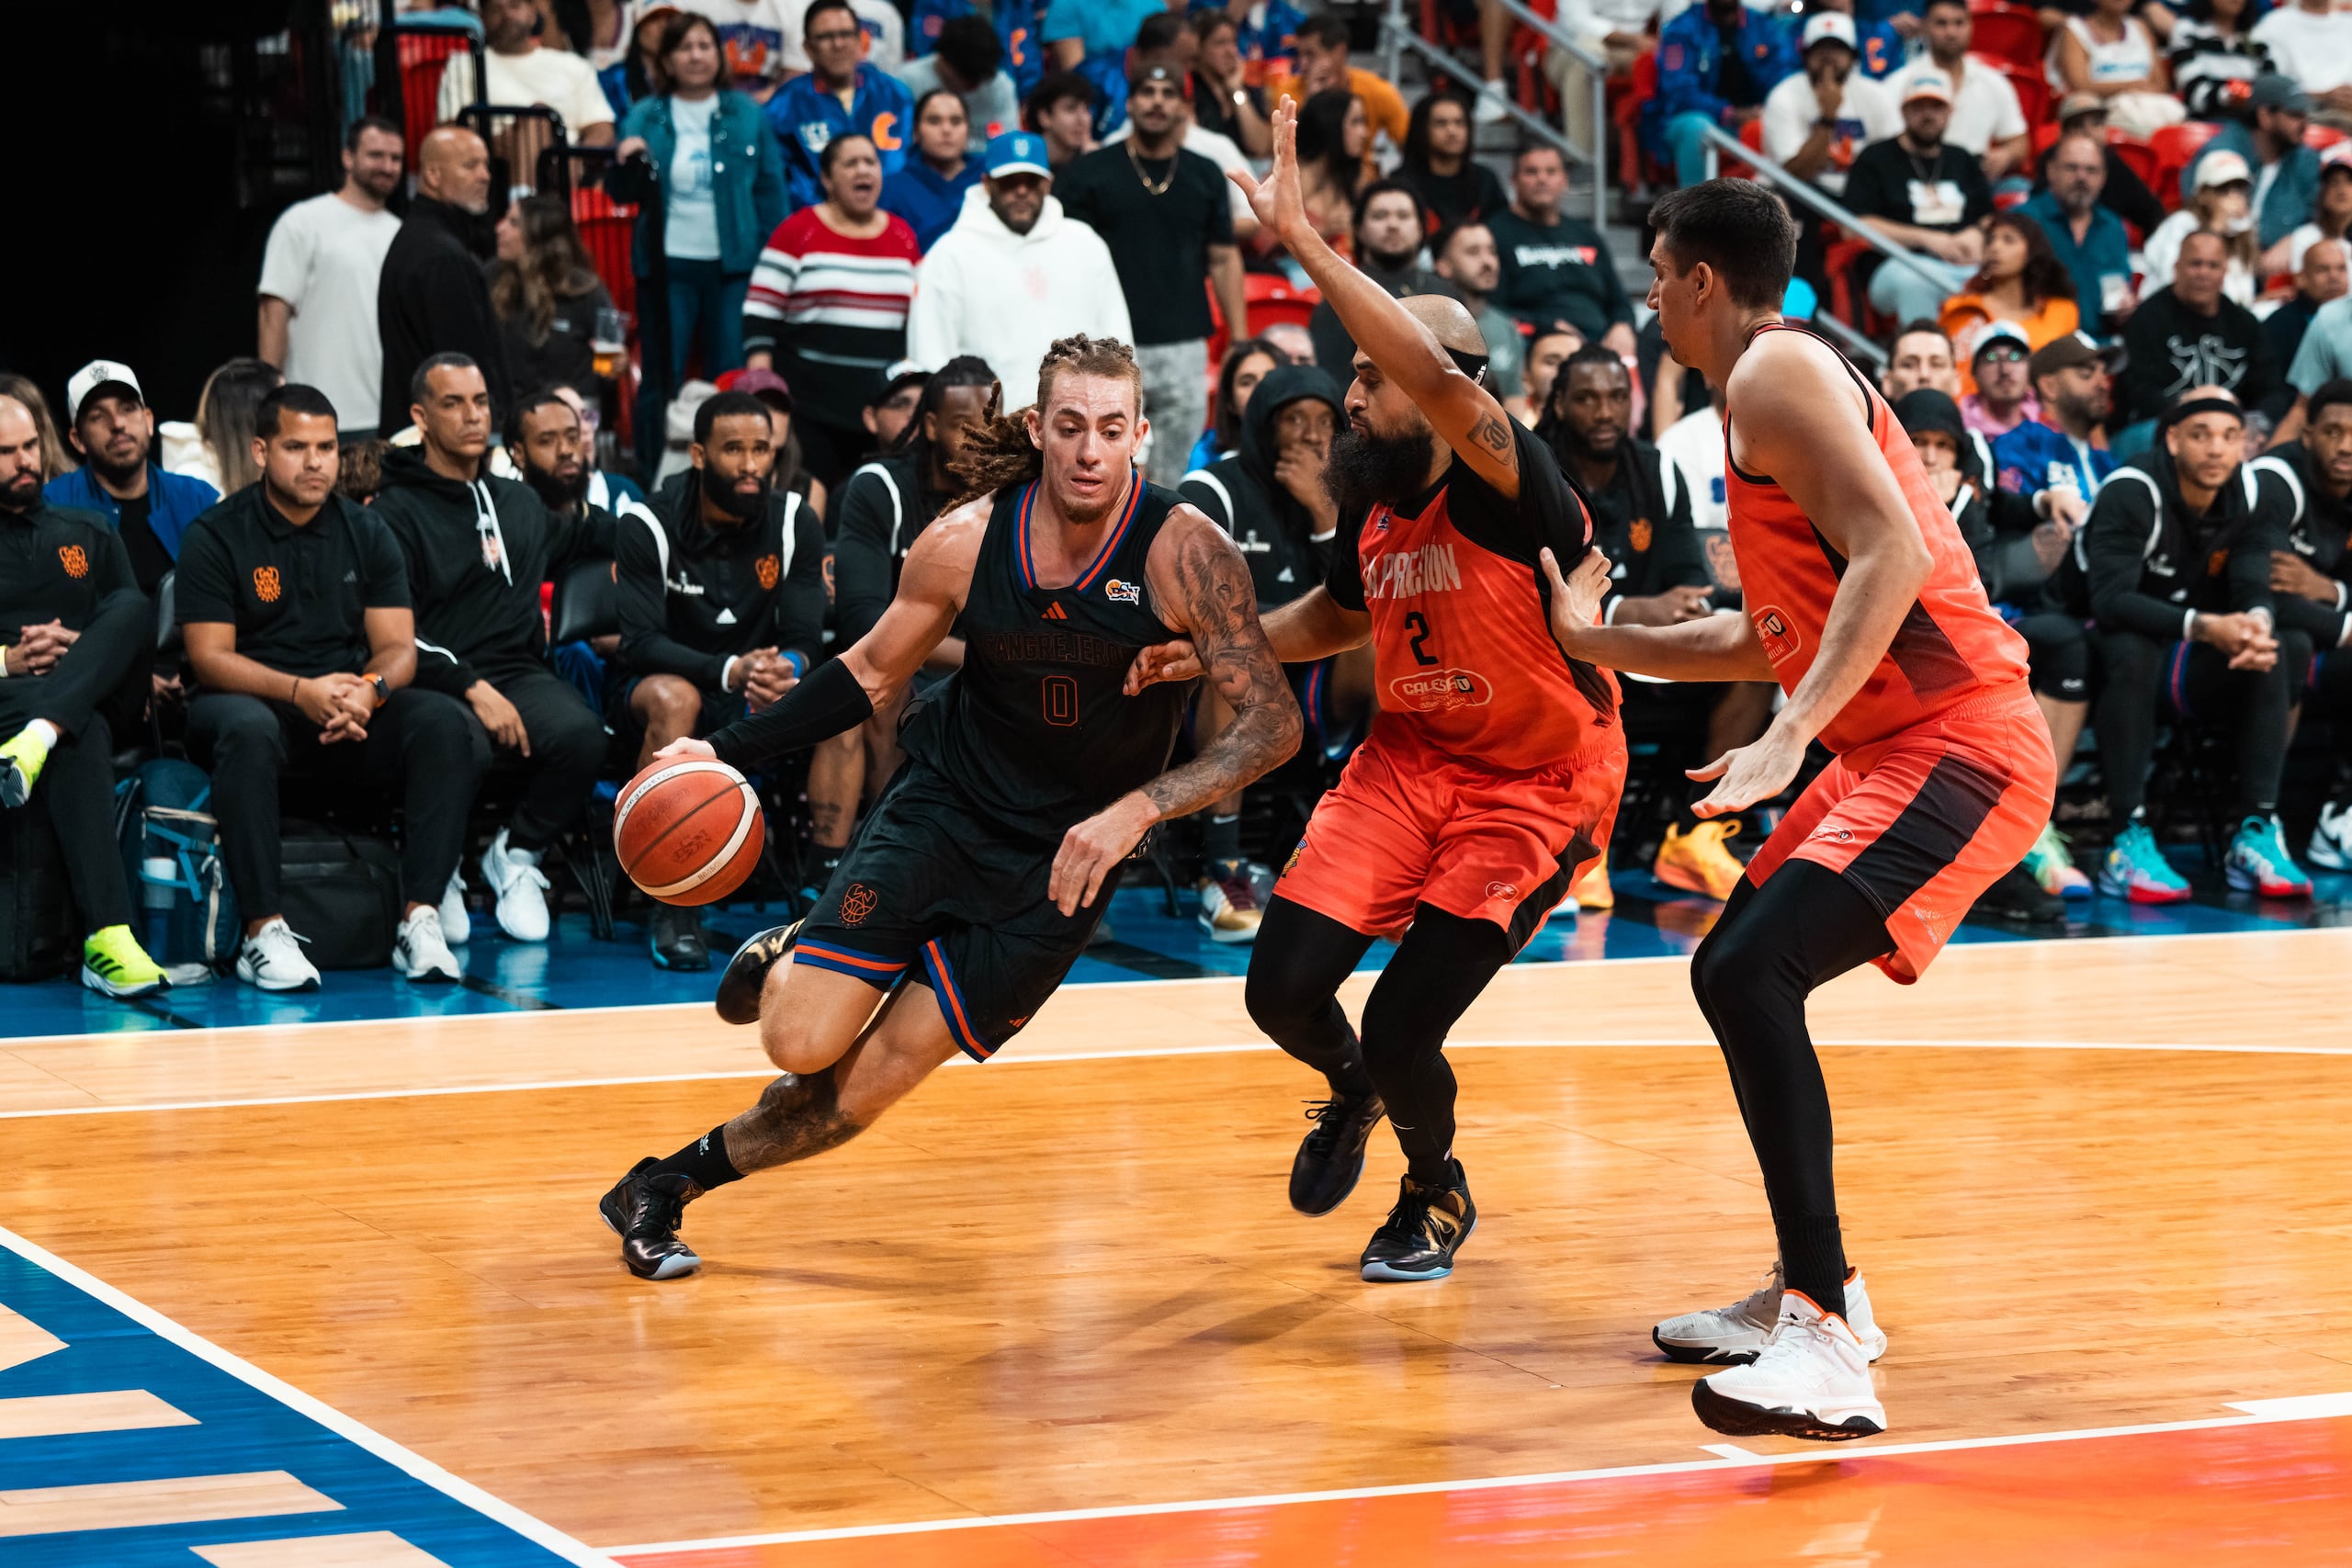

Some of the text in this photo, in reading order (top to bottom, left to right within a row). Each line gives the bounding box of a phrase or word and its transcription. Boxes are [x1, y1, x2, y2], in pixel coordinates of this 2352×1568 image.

[871, 111, 902, 152] C
[984, 630, 1125, 667] CANGREJERO
[1405, 612, 1439, 666] 2
[1042, 675, 1079, 727] 0
